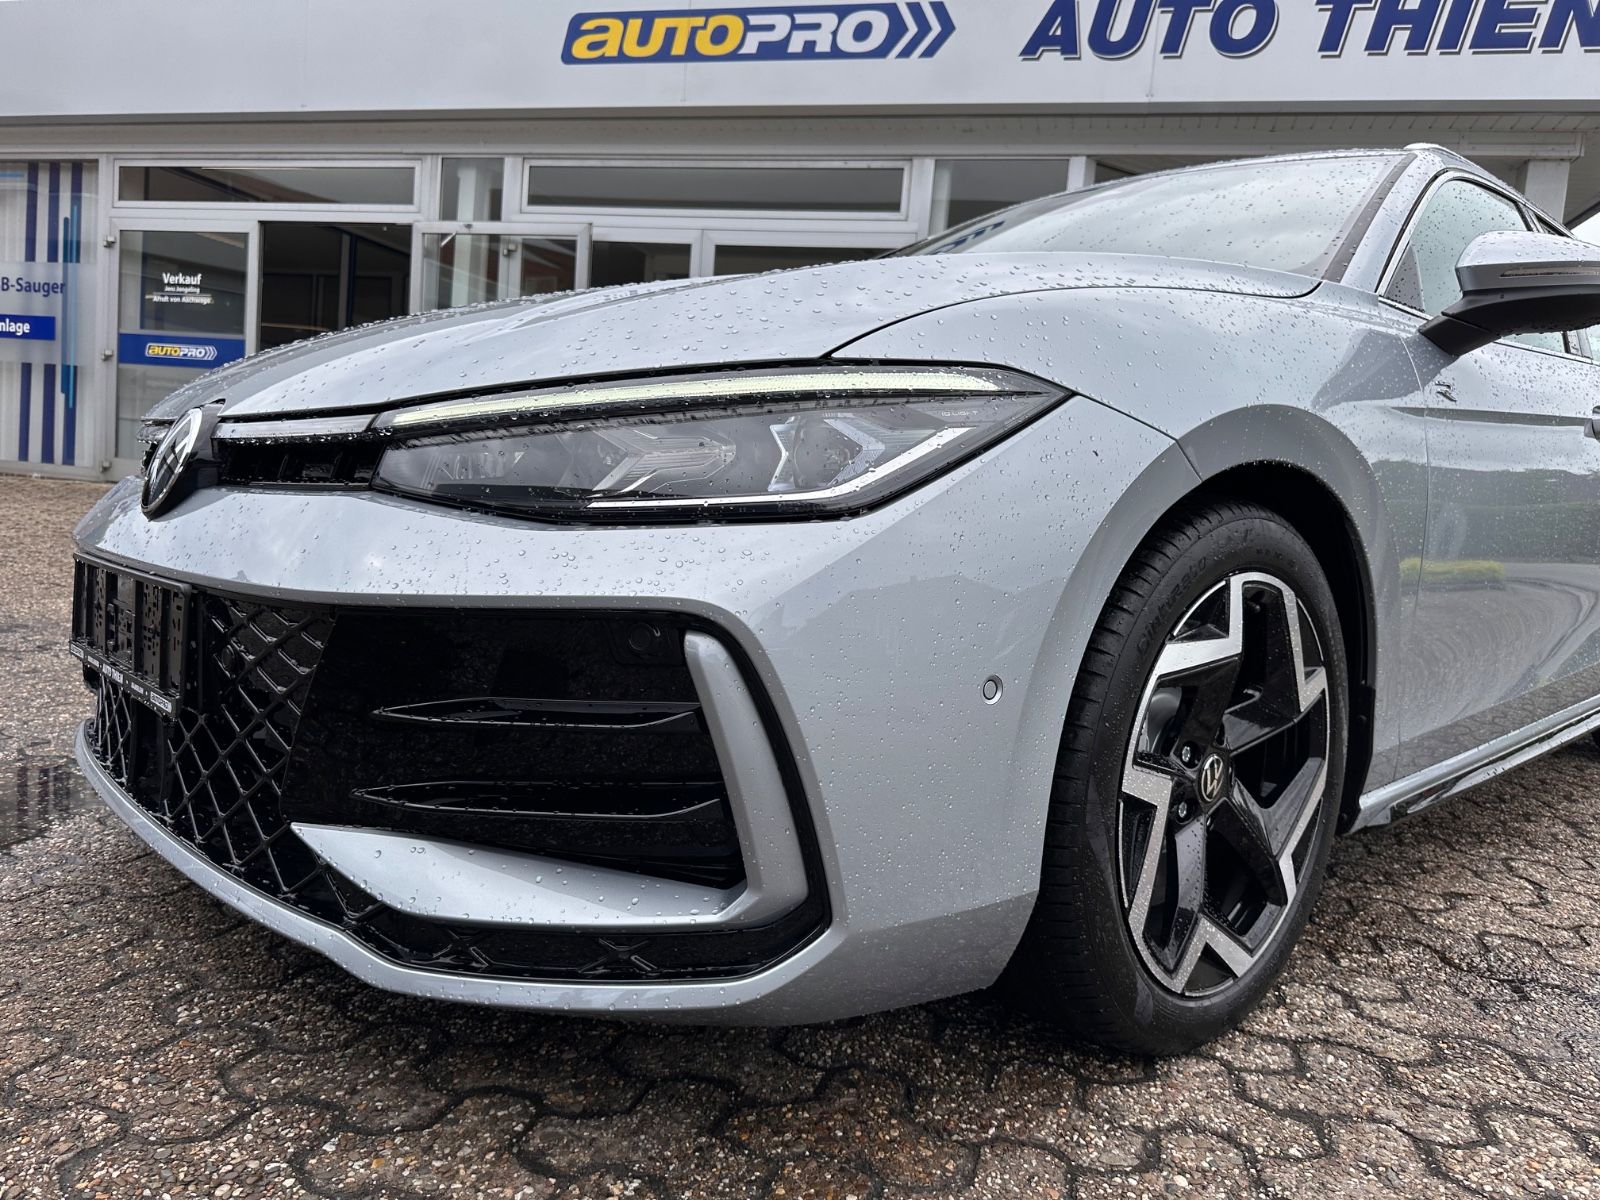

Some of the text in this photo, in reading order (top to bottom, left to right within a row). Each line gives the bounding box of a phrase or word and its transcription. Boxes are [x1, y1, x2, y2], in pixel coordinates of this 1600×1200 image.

[1018, 0, 1280, 60] AUTO
[1, 276, 66, 298] B-Sauger
[162, 272, 202, 285] Verkauf
[0, 318, 31, 336] nlage
